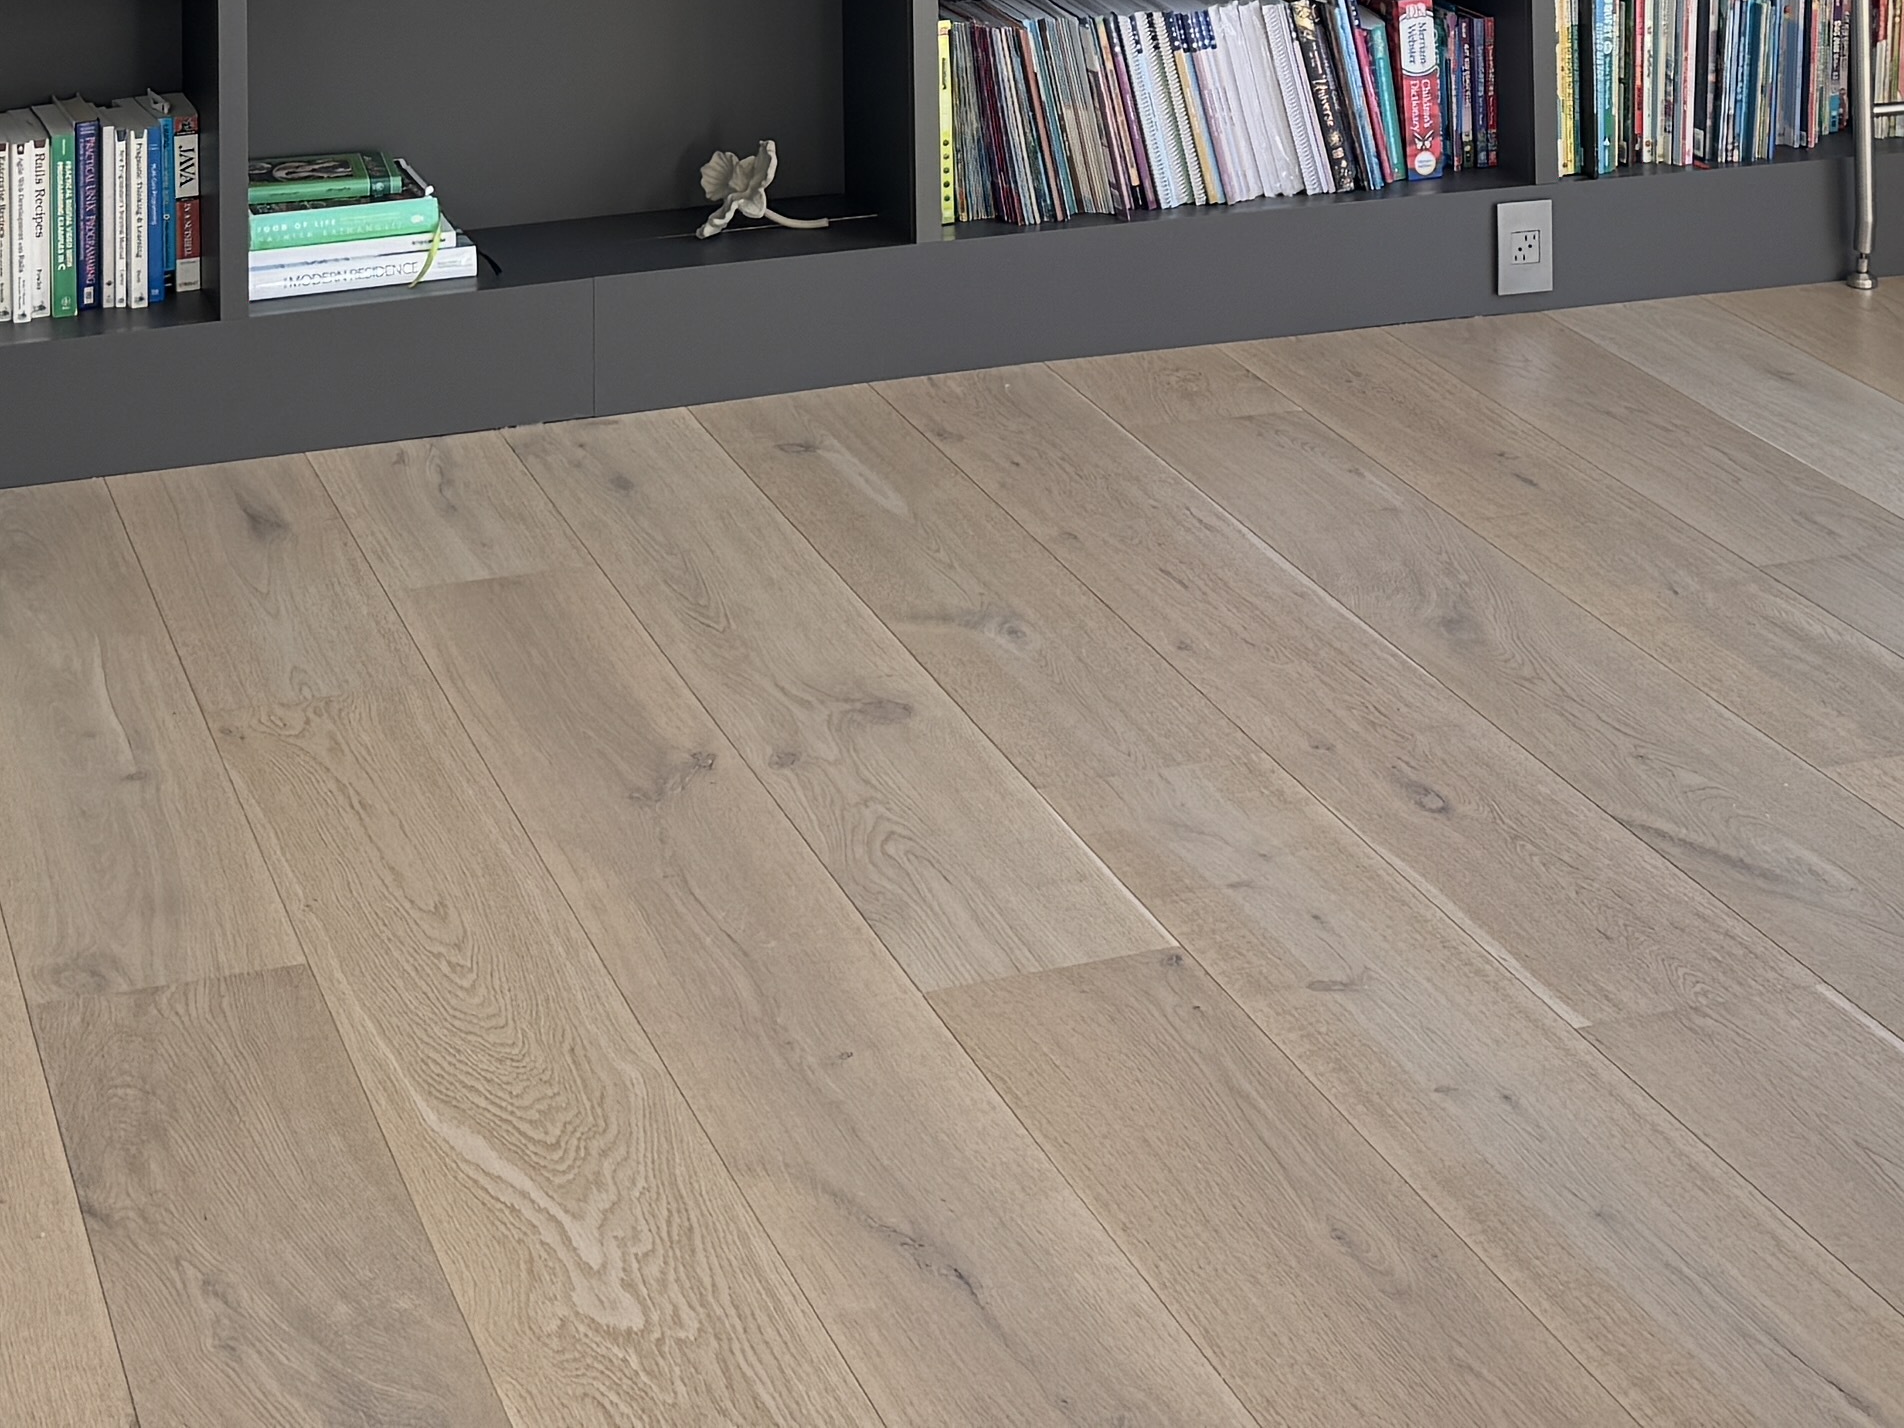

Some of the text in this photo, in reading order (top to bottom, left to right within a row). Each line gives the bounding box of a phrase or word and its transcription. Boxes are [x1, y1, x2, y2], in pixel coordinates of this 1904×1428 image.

[32, 153, 46, 237] Rails Recipes
[179, 145, 195, 188] JAVA
